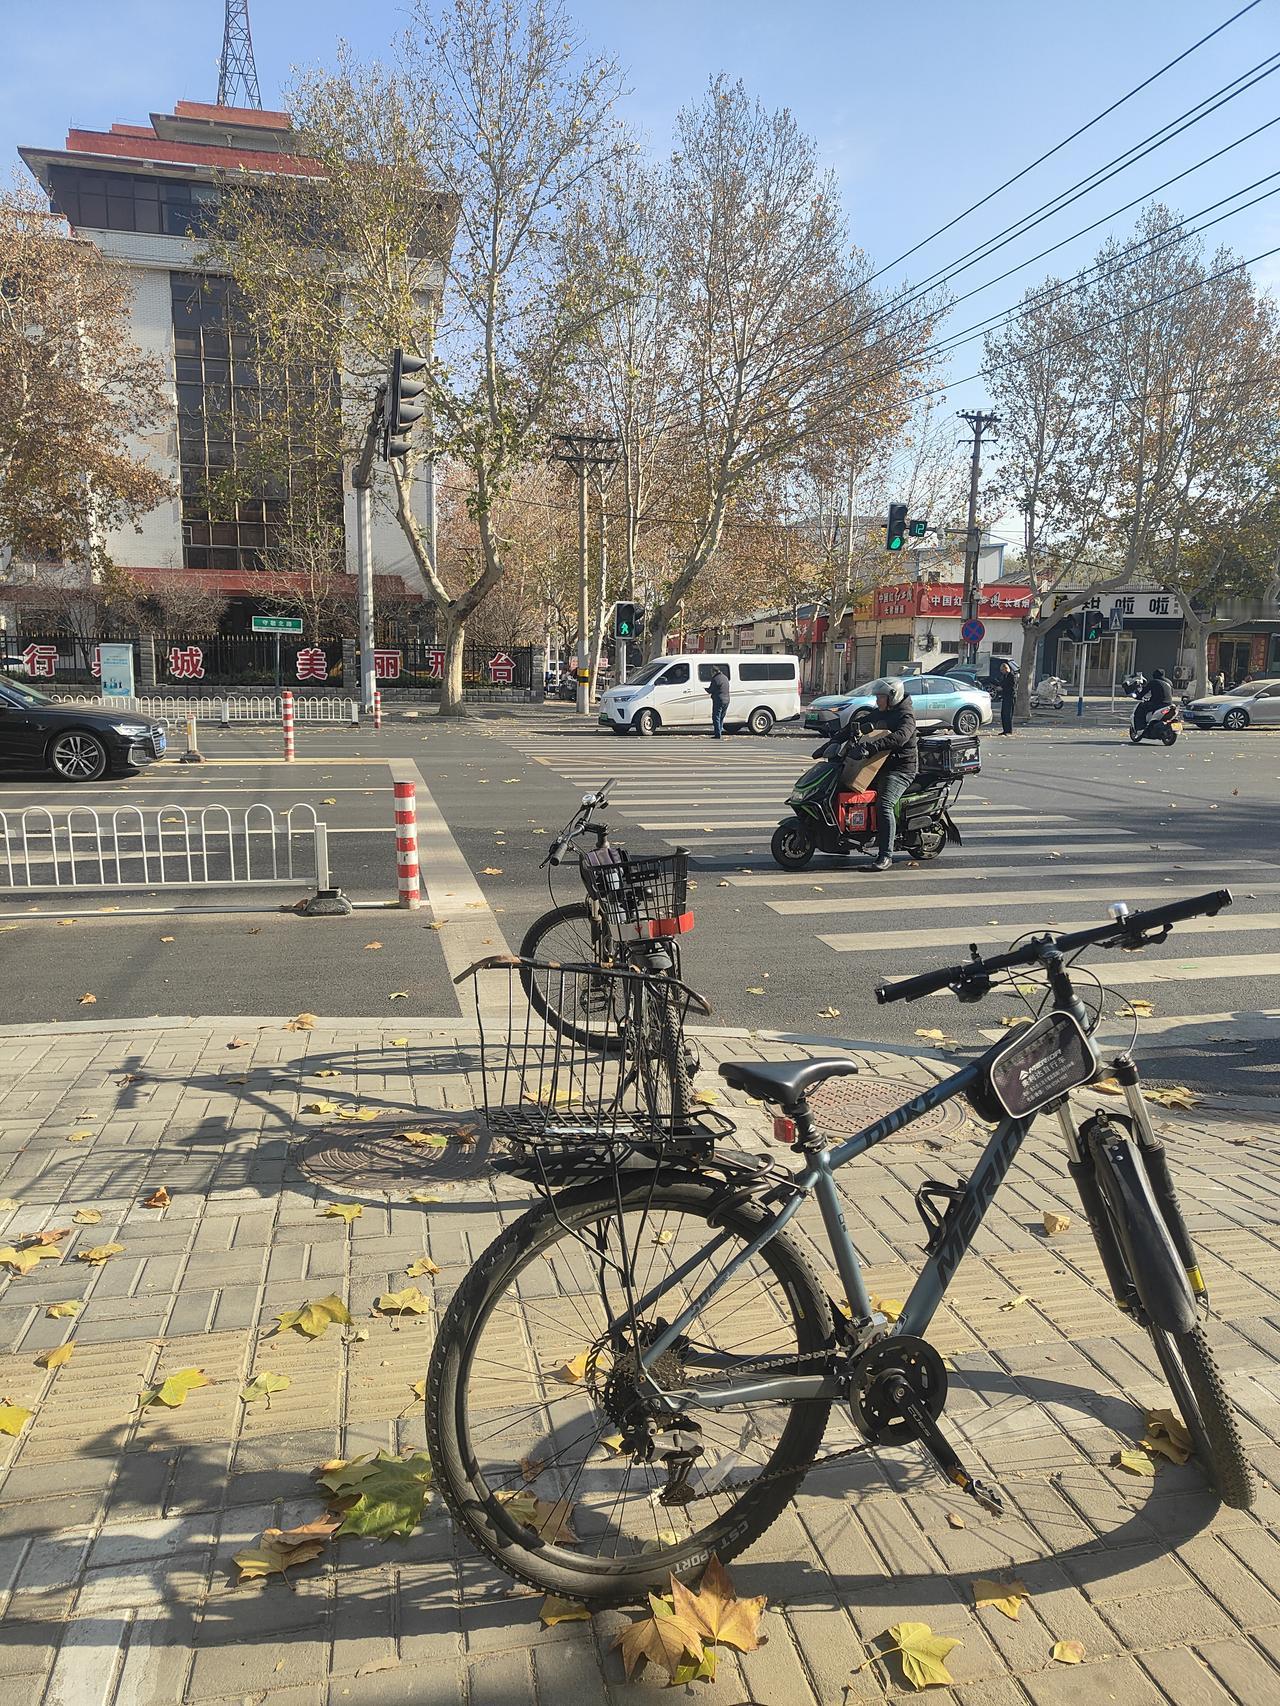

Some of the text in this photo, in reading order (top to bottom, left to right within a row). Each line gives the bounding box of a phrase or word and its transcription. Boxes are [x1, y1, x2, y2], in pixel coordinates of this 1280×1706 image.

[915, 523, 925, 535] 12
[935, 1112, 1034, 1292] MERID
[720, 1519, 749, 1550] CST
